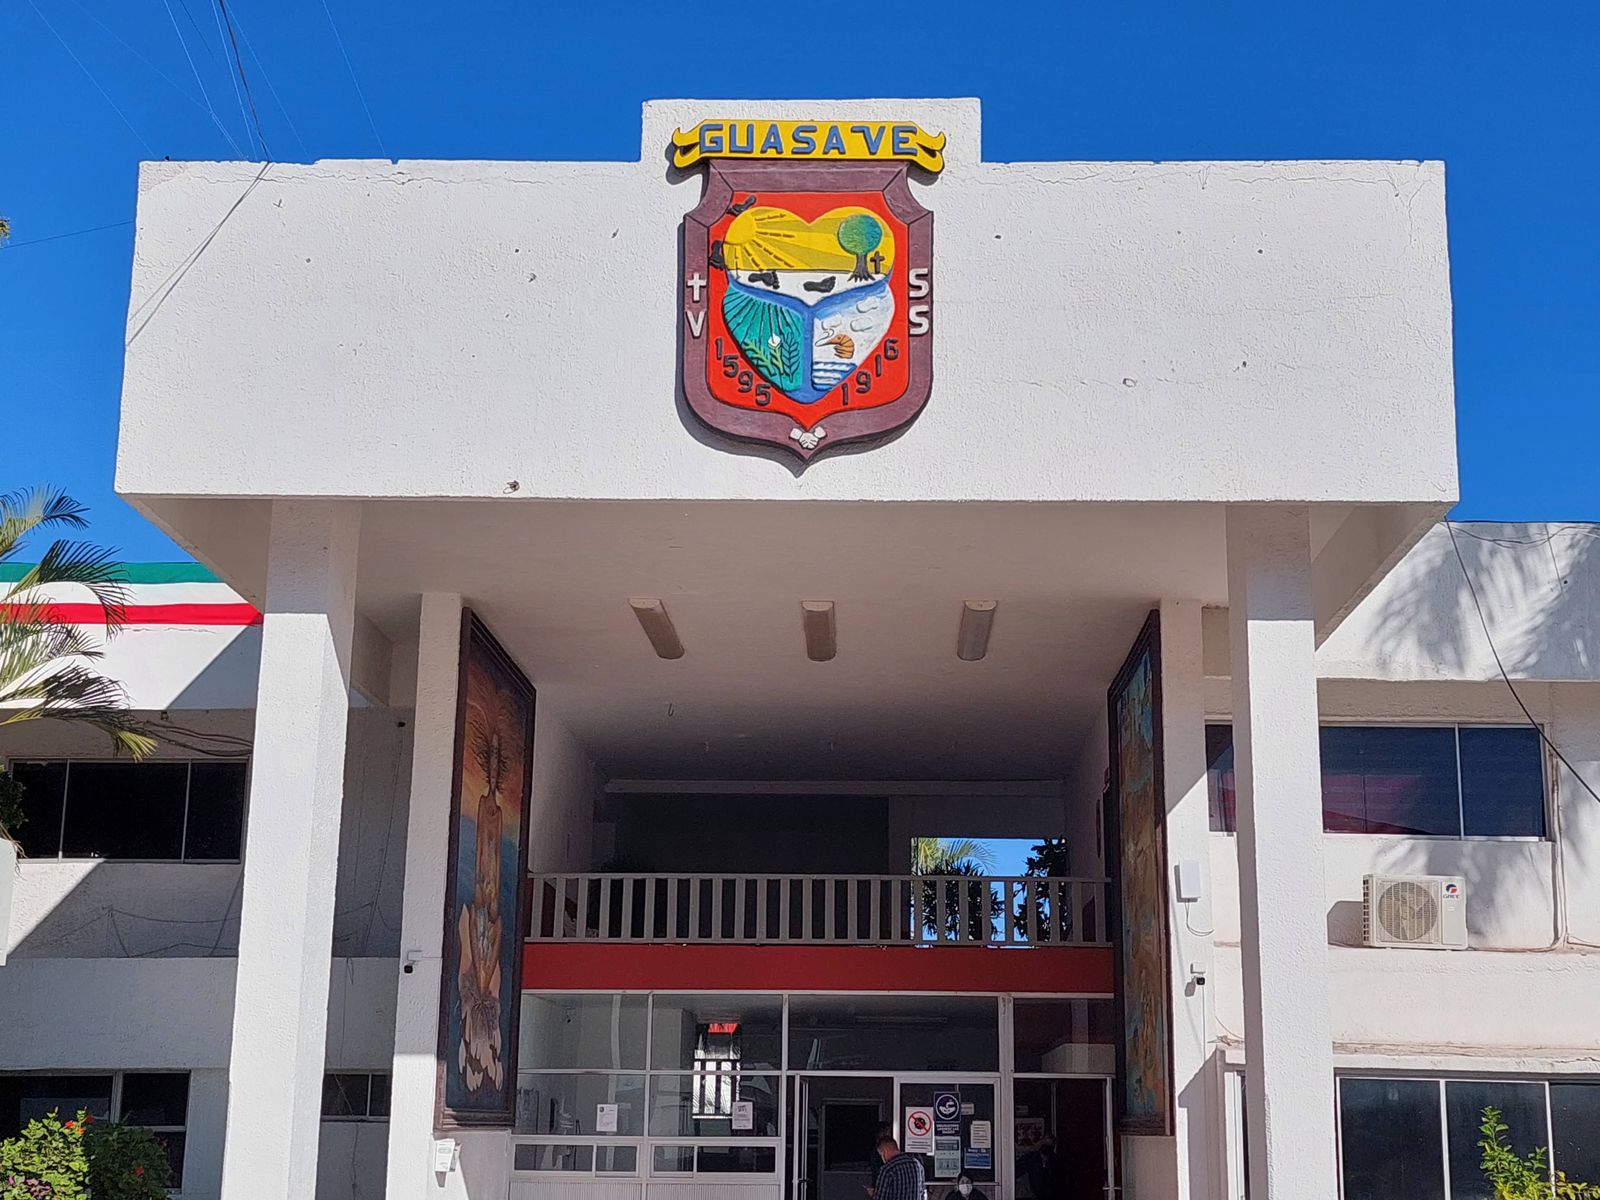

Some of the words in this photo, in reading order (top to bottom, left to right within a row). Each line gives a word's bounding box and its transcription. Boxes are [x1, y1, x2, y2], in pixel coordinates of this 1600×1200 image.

[700, 123, 917, 156] GUASAVE
[715, 337, 771, 406] 1595
[841, 338, 899, 406] 1916
